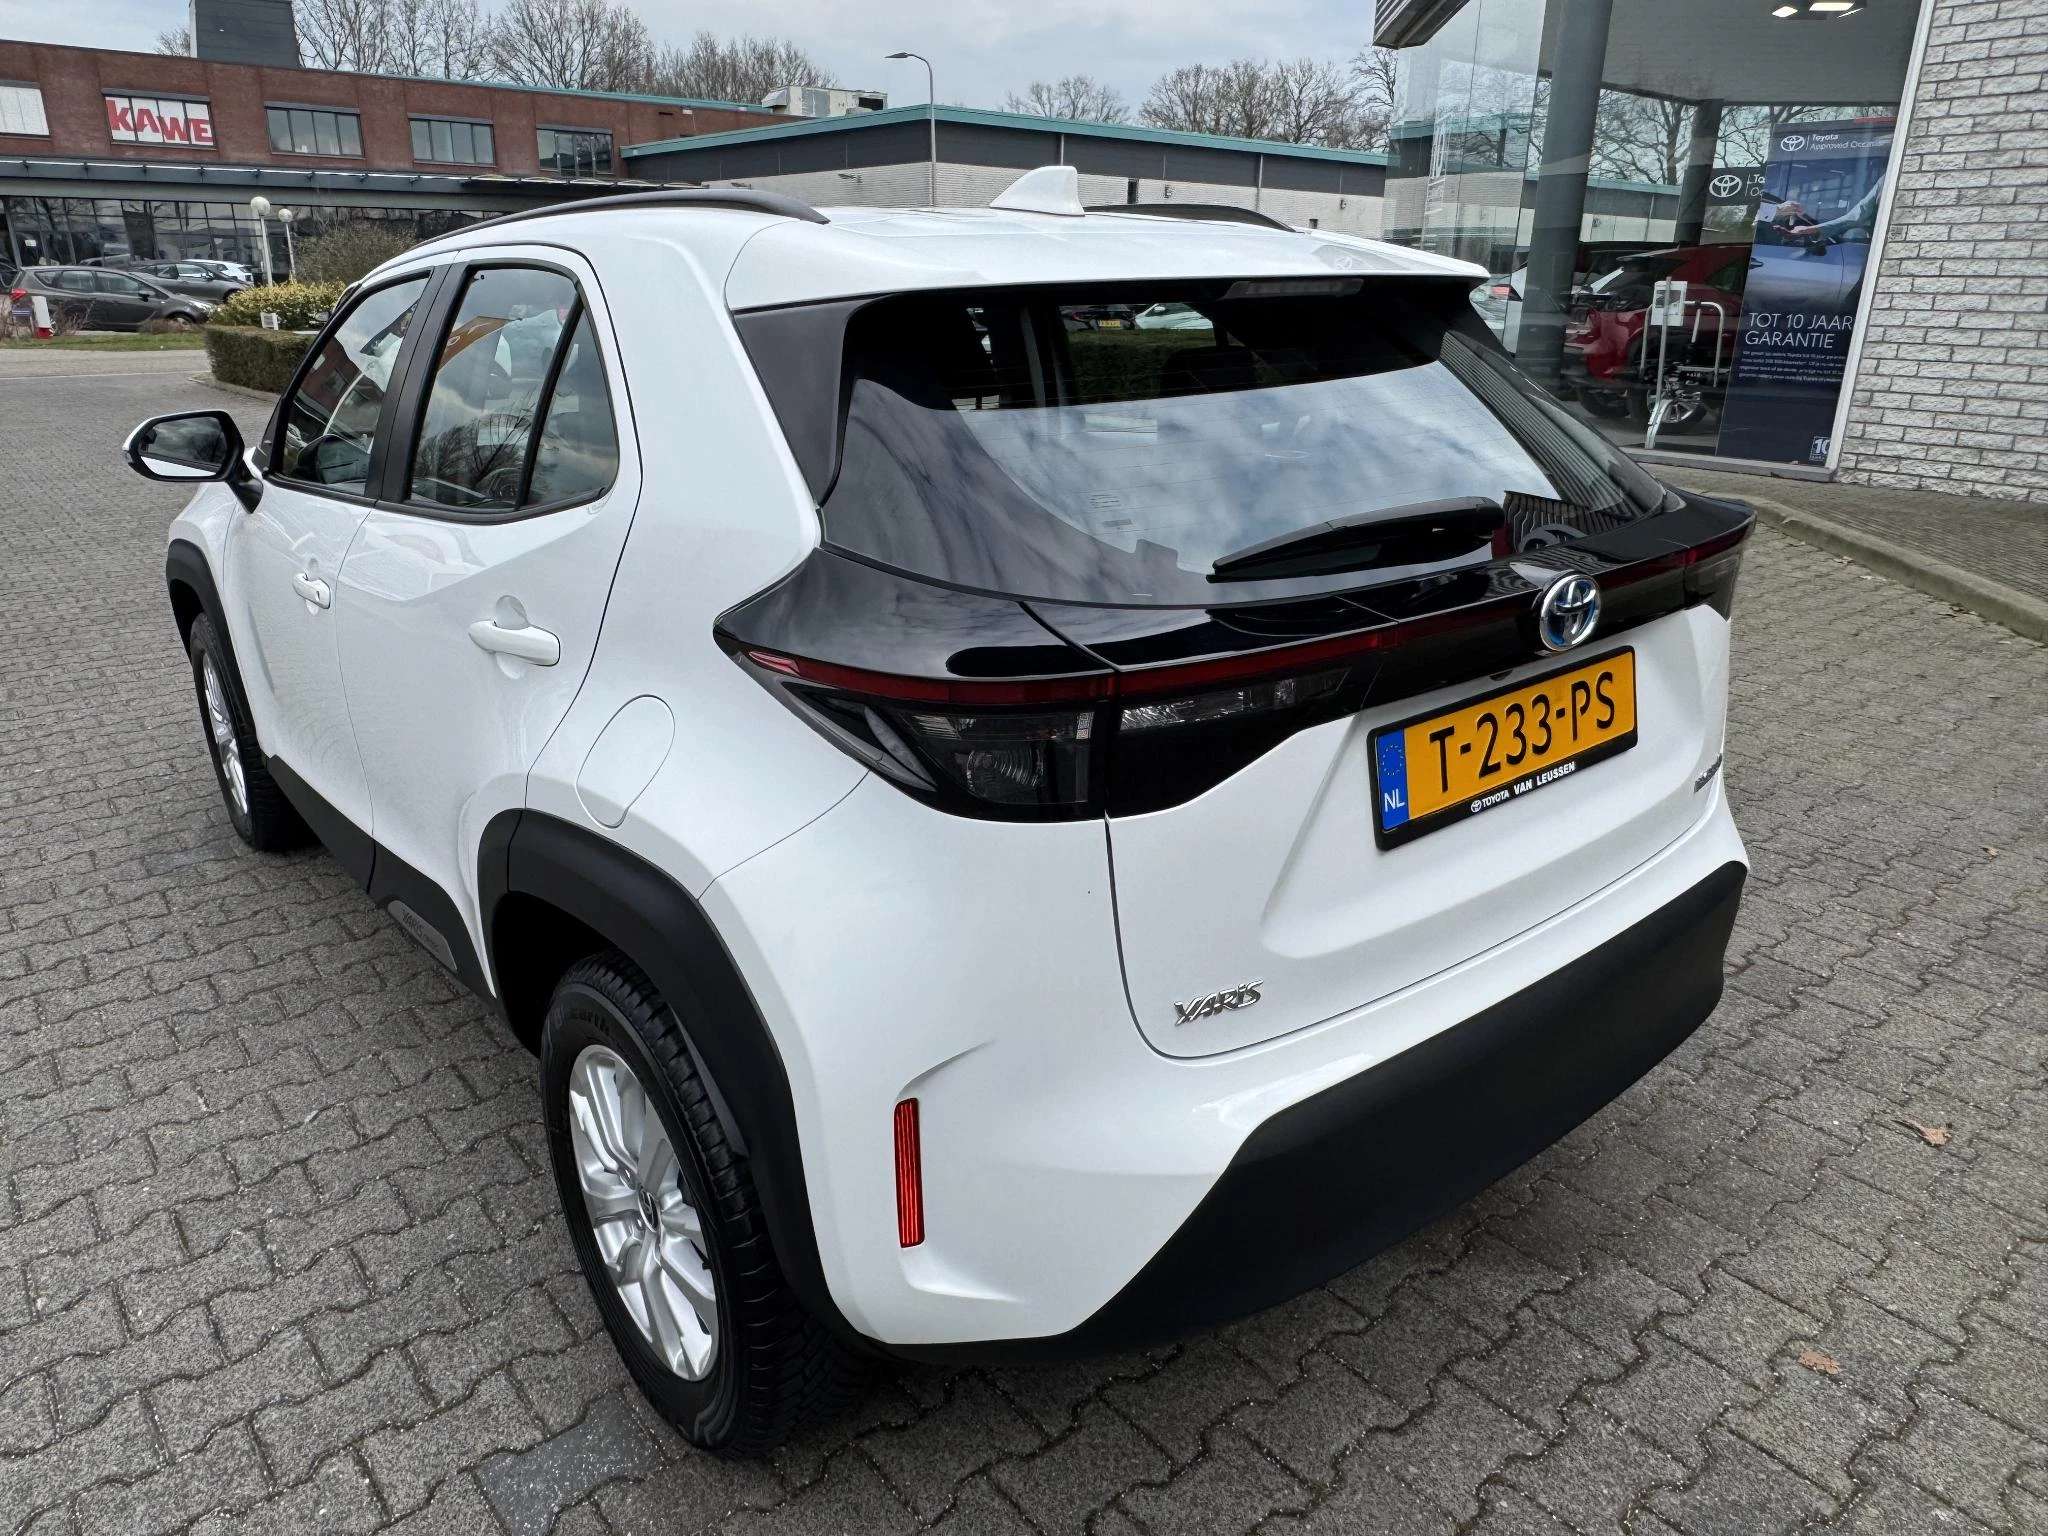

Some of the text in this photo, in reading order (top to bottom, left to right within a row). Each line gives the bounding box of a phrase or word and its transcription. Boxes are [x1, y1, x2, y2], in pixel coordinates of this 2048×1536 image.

[105, 99, 213, 142] KAWE
[1810, 141, 1849, 151] Approved
[1812, 133, 1839, 143] Toyota
[1748, 312, 1853, 330] TOT 10 JAAR
[1745, 330, 1835, 349] GARANTIE
[1428, 671, 1616, 793] T-233-PS
[1481, 760, 1576, 808] TOYOTA VAN LEUSSEN
[1384, 788, 1405, 813] NL
[1173, 979, 1265, 1028] YARIS
